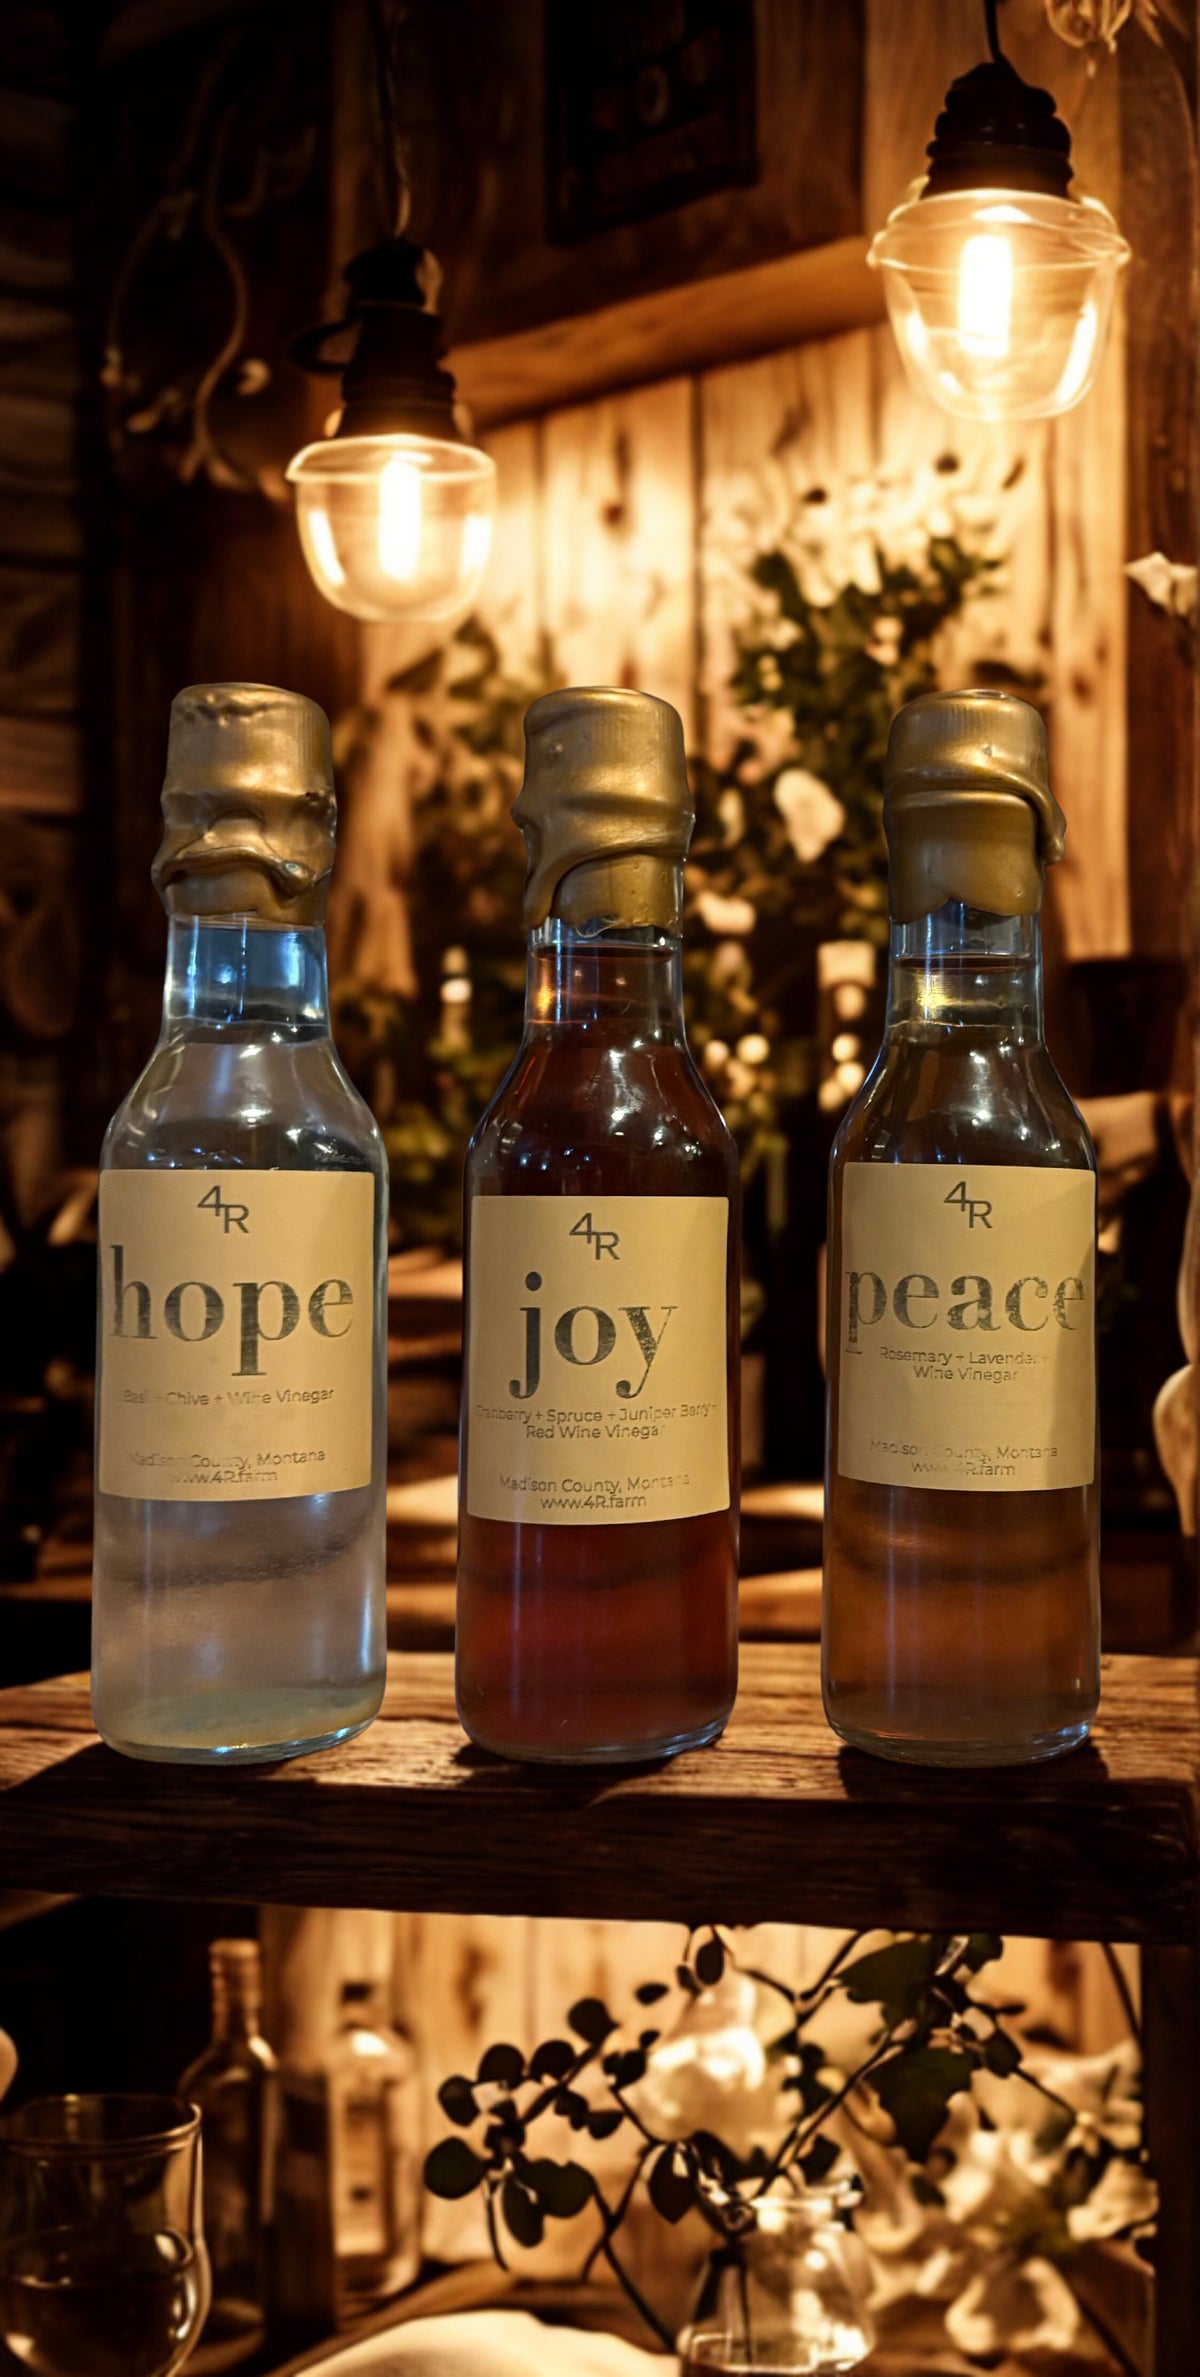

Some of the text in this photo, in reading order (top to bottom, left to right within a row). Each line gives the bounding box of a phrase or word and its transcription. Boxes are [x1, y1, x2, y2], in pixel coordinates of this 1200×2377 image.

[196, 1184, 250, 1234] 4R
[943, 1180, 993, 1229] 4R
[568, 1212, 621, 1261] 4R
[109, 1244, 354, 1377] hope
[845, 1271, 1085, 1355] peace
[508, 1270, 679, 1400] joy
[879, 1345, 954, 1367] Rosemary
[969, 1350, 1037, 1365] Lavende
[913, 1364, 1019, 1385] Wine Vinegar
[124, 1389, 149, 1404] Bas
[167, 1391, 210, 1406] Chive
[275, 1388, 335, 1405] Vinegar
[546, 1408, 603, 1425] Spruce
[619, 1405, 677, 1423] Juniper
[680, 1403, 711, 1418] Berry
[526, 1423, 667, 1440] Red Wine Vinega
[191, 1453, 252, 1471] Couty,
[256, 1449, 326, 1466] Montana
[871, 1437, 928, 1457] Madso
[932, 1445, 992, 1465] ount,
[171, 1469, 279, 1485] ww.4R.farm
[561, 1477, 622, 1495] County,
[626, 1473, 690, 1491] Montaa
[540, 1493, 647, 1510] www.4R.farm
